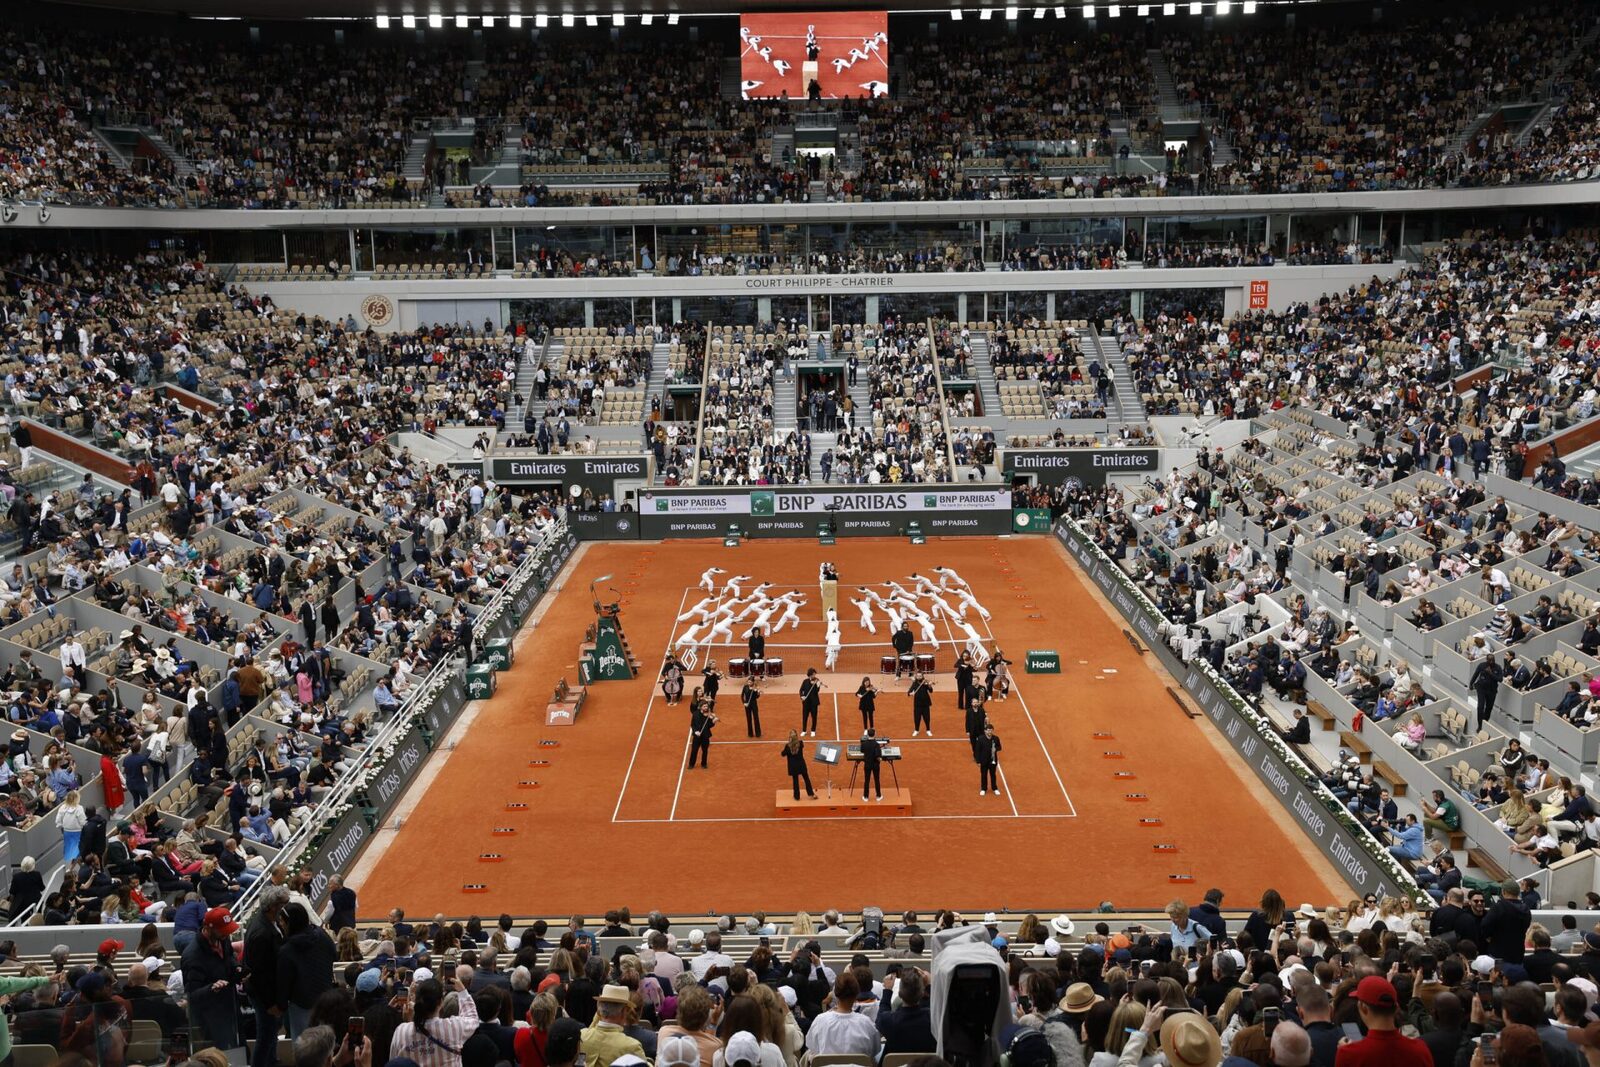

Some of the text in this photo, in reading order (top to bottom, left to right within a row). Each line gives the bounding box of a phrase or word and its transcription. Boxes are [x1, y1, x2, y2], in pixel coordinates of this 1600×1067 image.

[746, 279, 781, 288] COURT
[785, 278, 832, 287] PHILIPPE
[841, 277, 893, 286] CHATRIER
[1252, 284, 1266, 293] TEN
[1252, 297, 1265, 305] NIS
[1014, 455, 1070, 468] Emirates
[1093, 453, 1149, 467] Emirates
[510, 462, 567, 475] Emirates
[584, 461, 640, 474] Emirates
[671, 498, 727, 507] BNP PARIBAS
[779, 494, 907, 511] BNP PARIBAS
[939, 494, 996, 503] BNP PARIBAS
[1139, 616, 1158, 642] RENAULT
[1031, 660, 1056, 669] Haier
[1260, 754, 1290, 795] Emirates
[1293, 790, 1326, 837] Emirates
[327, 821, 363, 872] Emirates
[1329, 832, 1368, 885] Emirates
